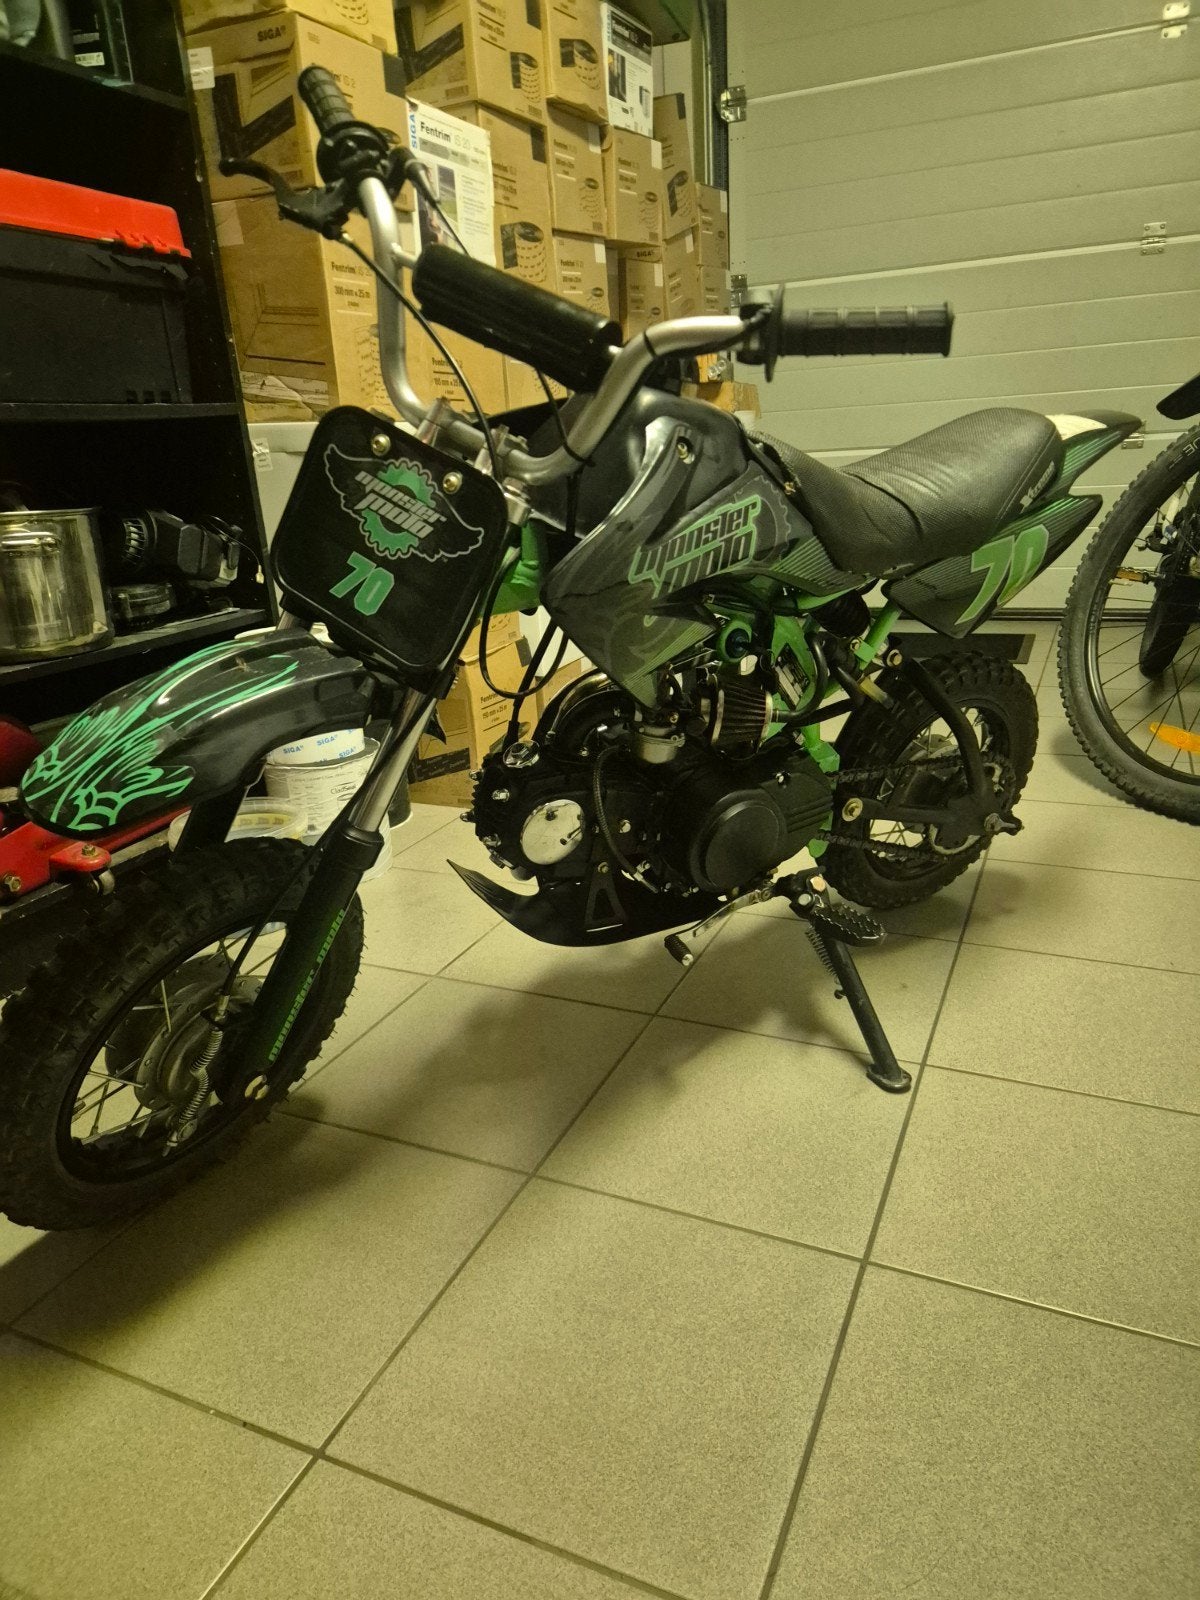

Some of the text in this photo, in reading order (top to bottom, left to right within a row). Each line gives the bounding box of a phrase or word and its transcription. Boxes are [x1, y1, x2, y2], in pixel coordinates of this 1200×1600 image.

[420, 121, 452, 143] Fentrim
[329, 551, 395, 616] 70
[953, 523, 1050, 626] 70
